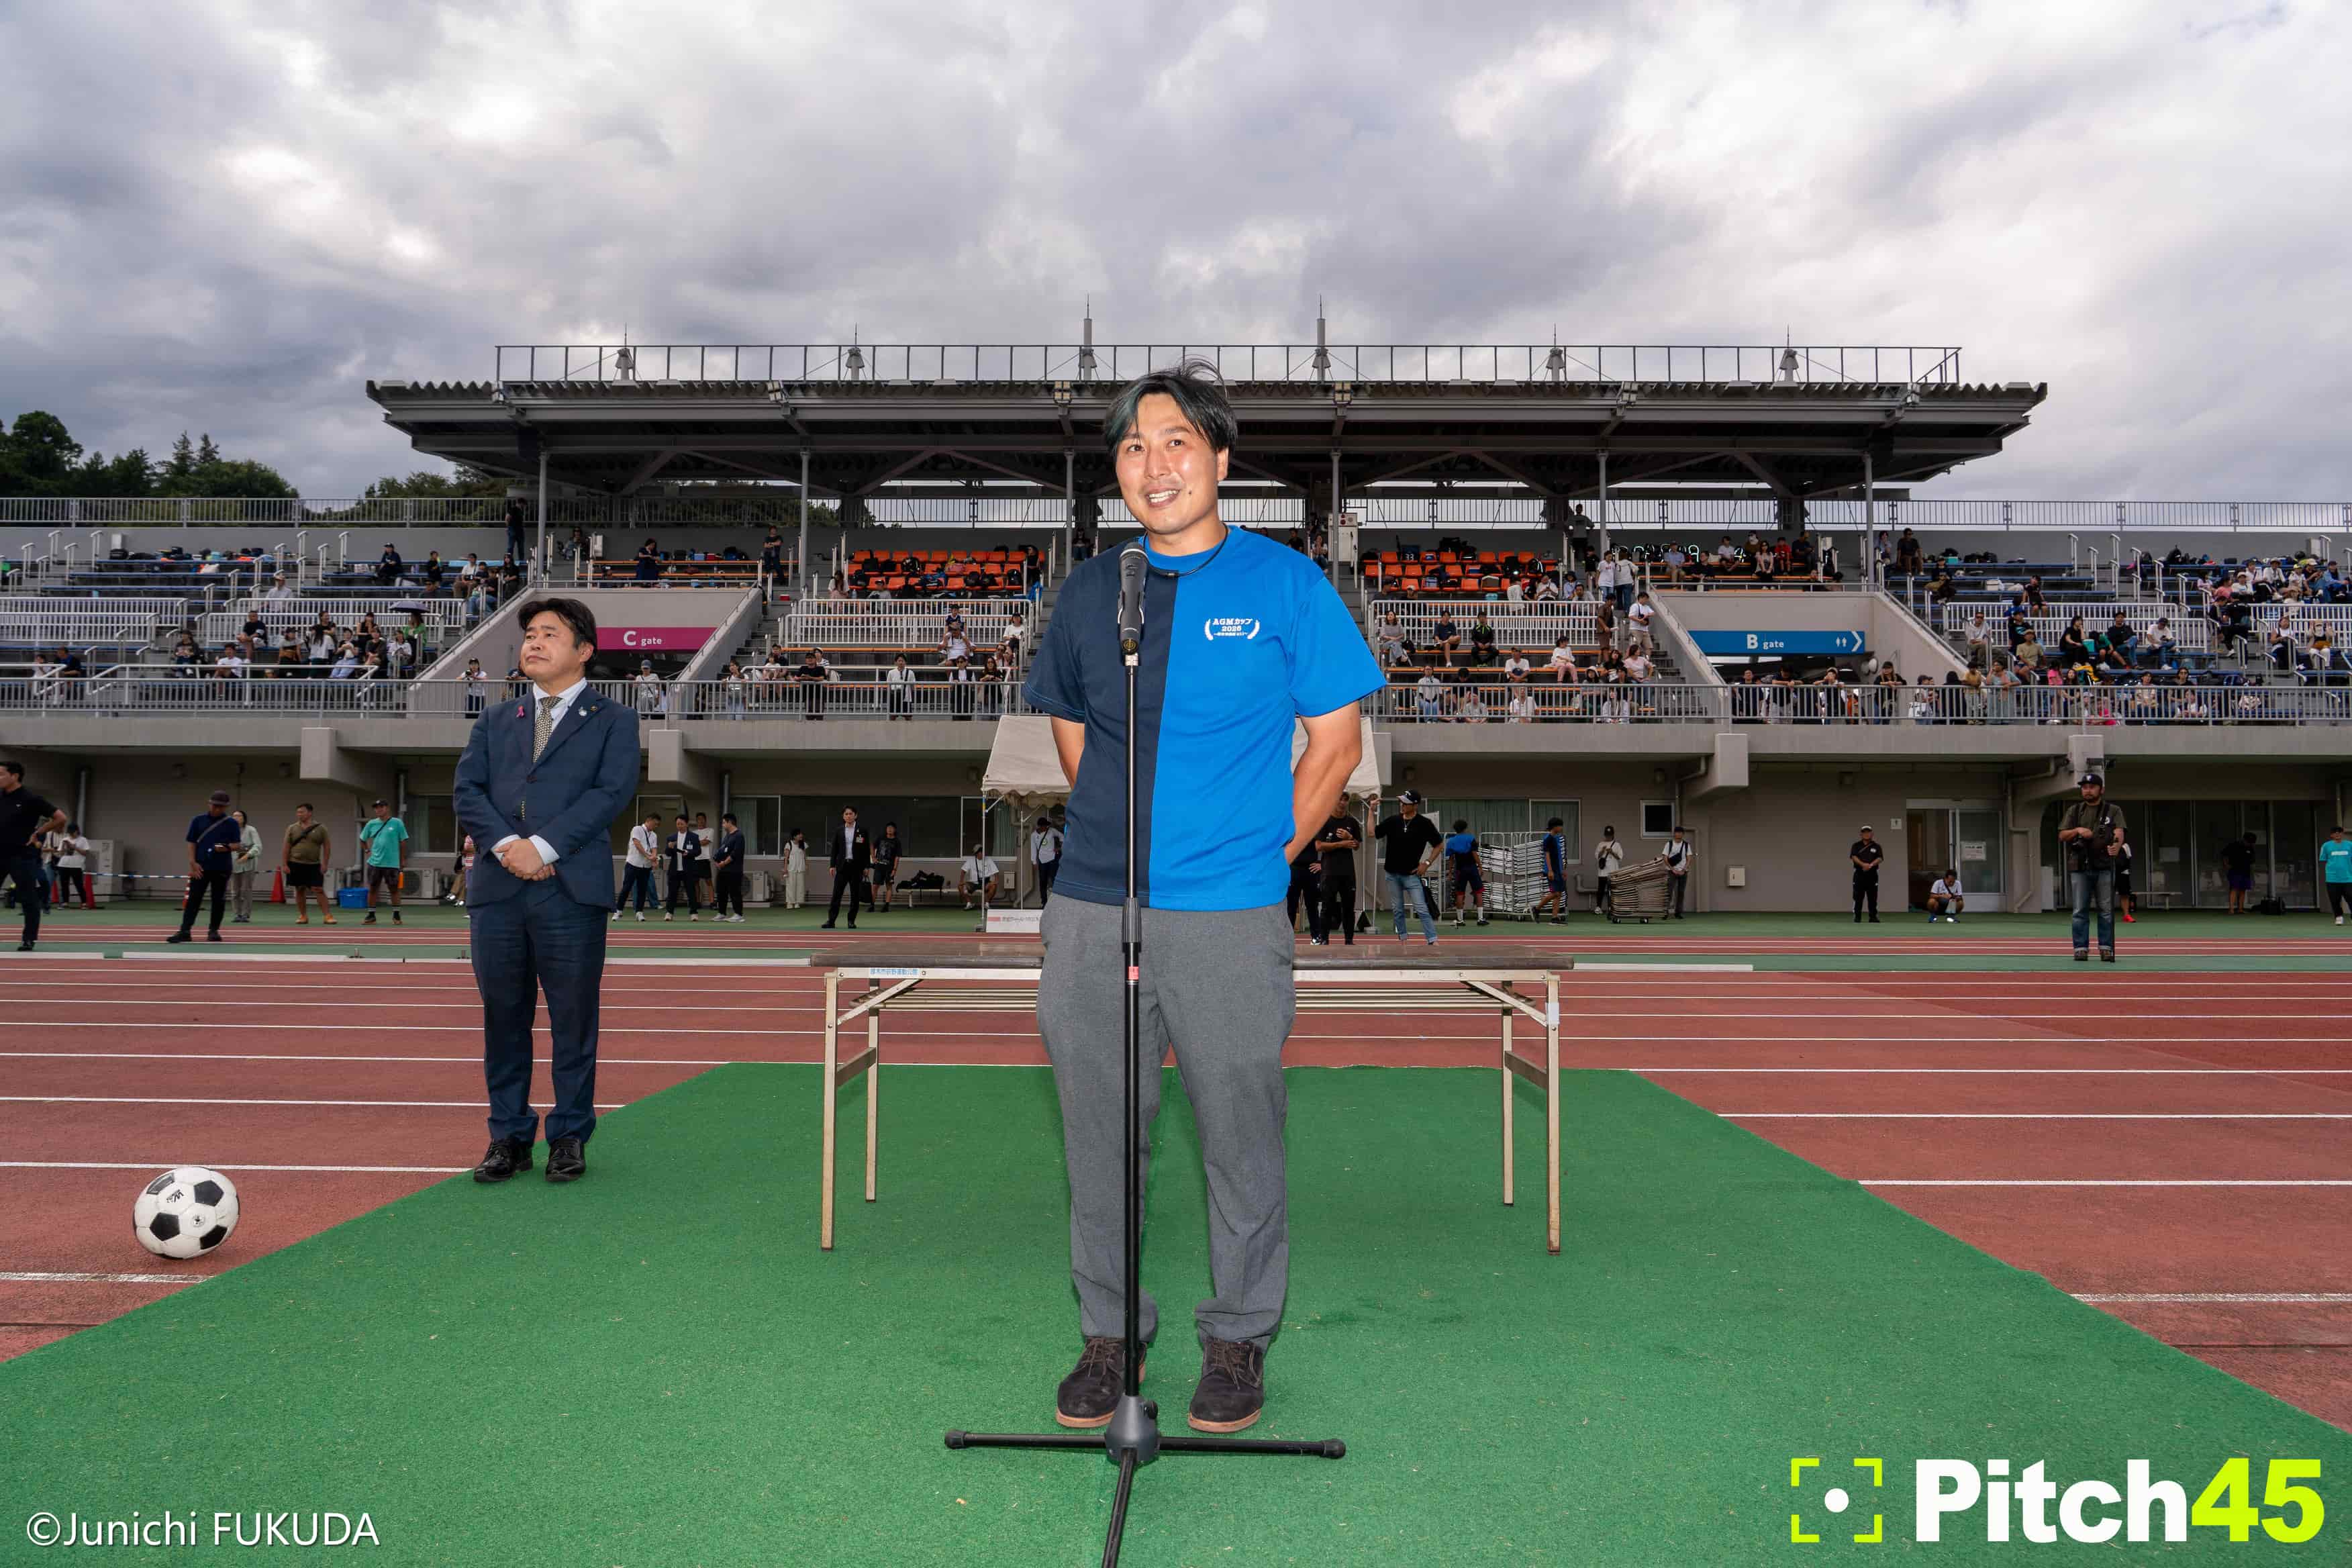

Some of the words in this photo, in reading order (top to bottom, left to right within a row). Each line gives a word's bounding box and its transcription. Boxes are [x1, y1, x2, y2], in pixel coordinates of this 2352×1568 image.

[623, 631, 636, 646] C
[641, 637, 662, 646] gate
[1747, 634, 1758, 649] B
[1763, 640, 1784, 650] gate
